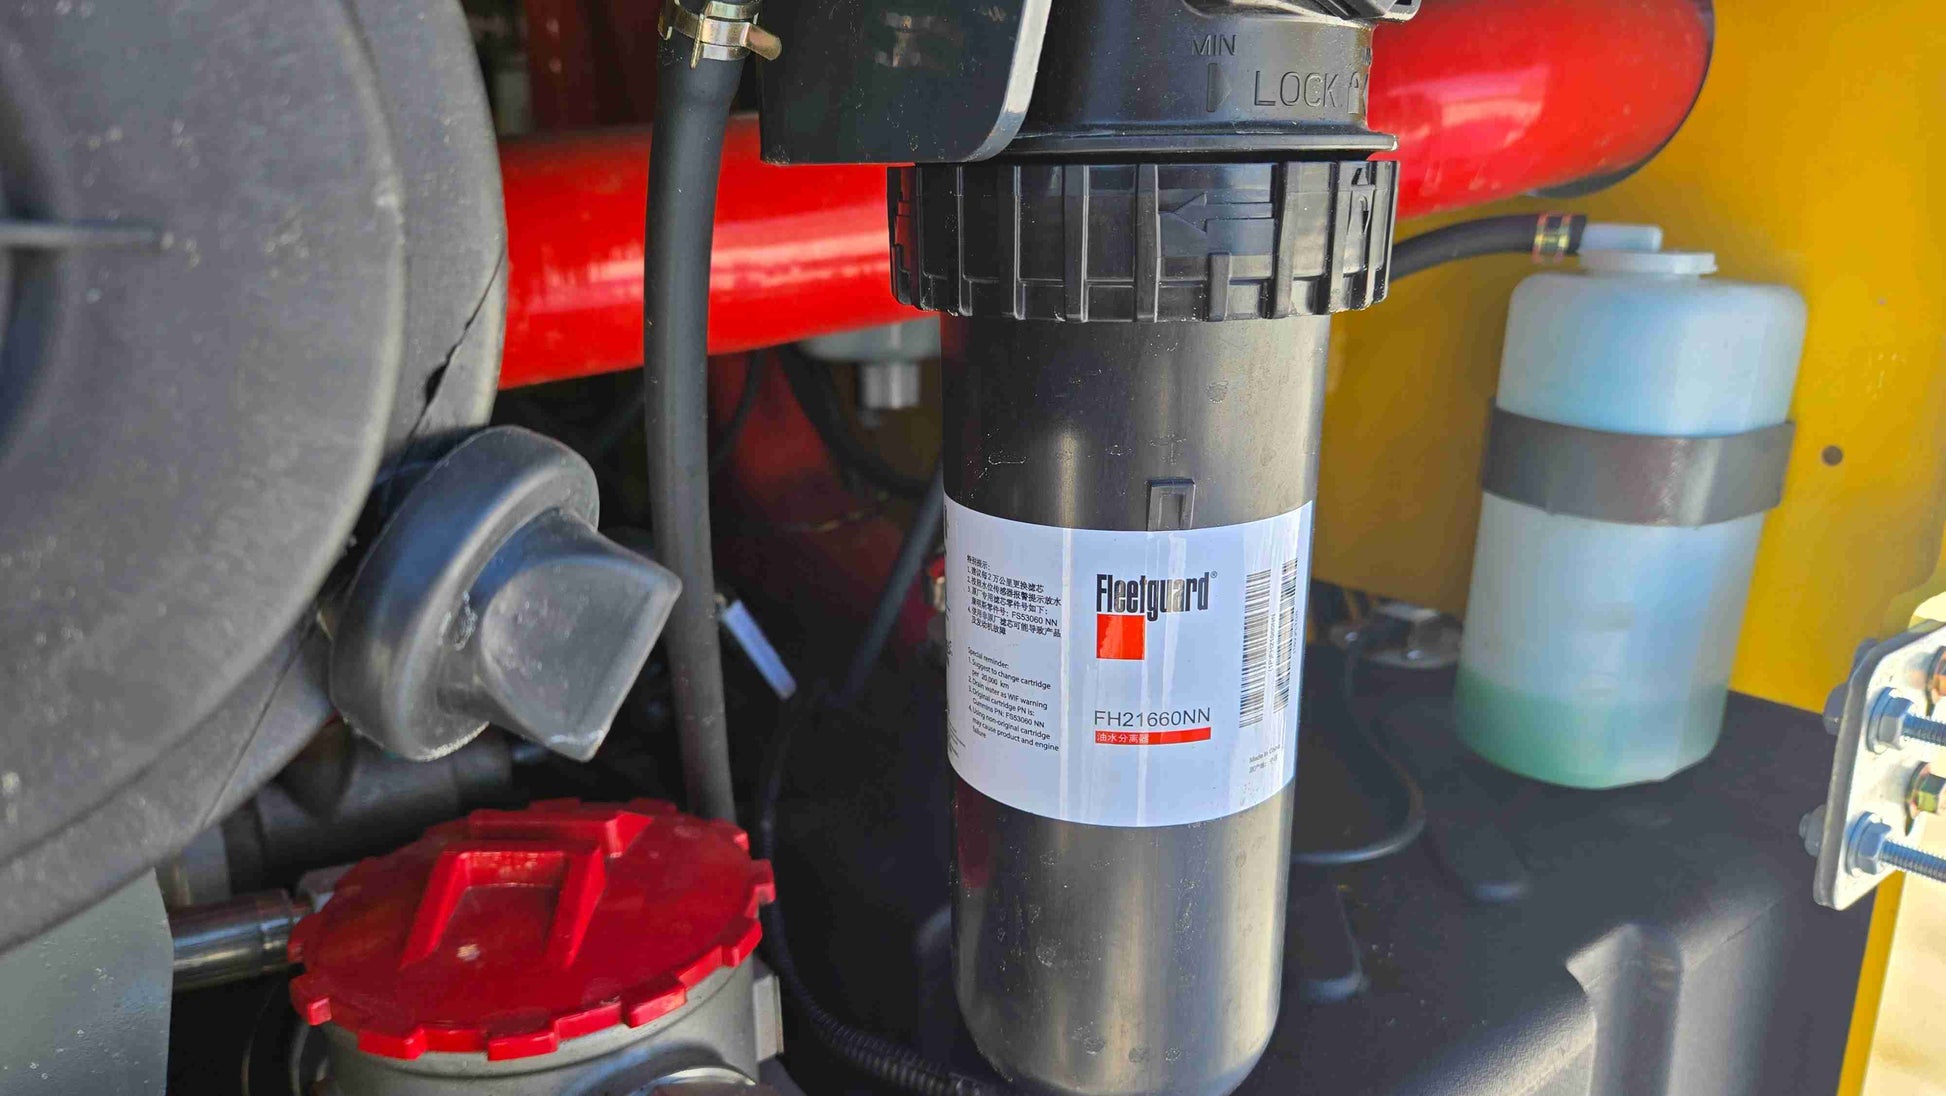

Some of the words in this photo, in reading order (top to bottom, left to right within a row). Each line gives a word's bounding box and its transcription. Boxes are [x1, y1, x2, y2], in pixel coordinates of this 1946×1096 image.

[1192, 34, 1237, 56] MIN
[1254, 70, 1339, 108] LOCK
[1045, 618, 1058, 627] NN
[998, 670, 1020, 683] change
[1020, 678, 1051, 690] cartridge
[991, 697, 1016, 712] cartridge
[1017, 705, 1026, 714] PN
[1020, 699, 1048, 711] warning
[1033, 720, 1045, 728] NN
[1094, 707, 1211, 727] FH21660NN
[986, 714, 1020, 732] non-original
[1020, 727, 1051, 741] cartridge
[997, 729, 1020, 743] product
[1020, 737, 1034, 746] and
[1034, 741, 1060, 752] engine
